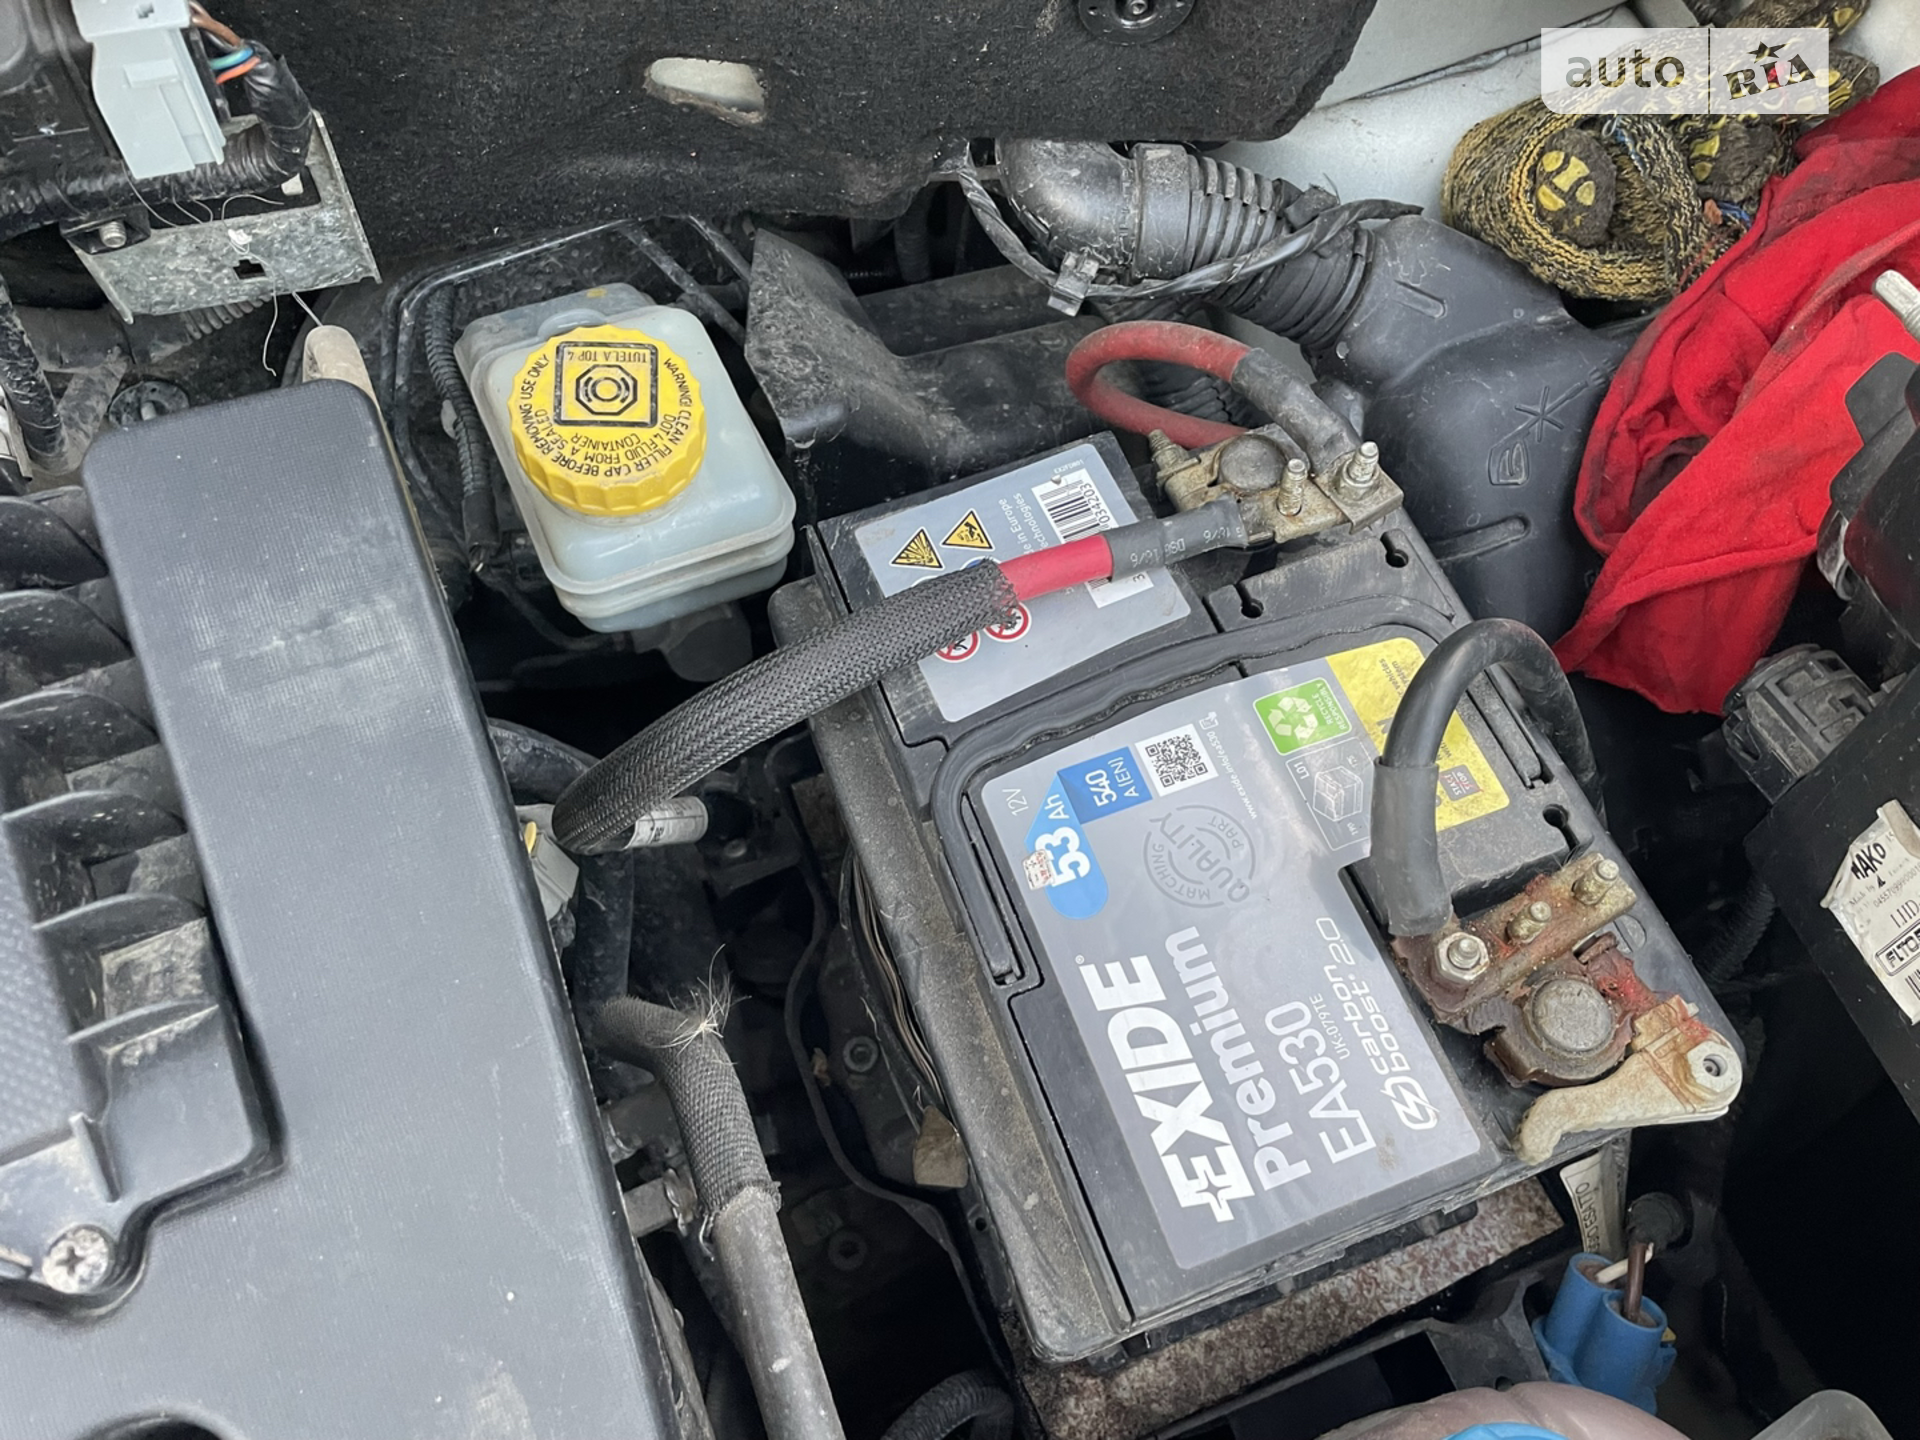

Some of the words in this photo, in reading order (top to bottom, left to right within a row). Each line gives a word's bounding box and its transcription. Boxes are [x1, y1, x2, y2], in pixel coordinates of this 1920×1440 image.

[528, 354, 551, 377] ONLY
[567, 351, 574, 360] 4
[578, 350, 598, 361] TOP
[602, 350, 648, 363] TUTELA
[521, 379, 536, 398] USE
[664, 358, 692, 407] WARNING!
[519, 403, 554, 456] REMOVING
[534, 408, 568, 448] SEALED
[653, 430, 662, 440] 4
[658, 413, 677, 435] DOT
[668, 411, 691, 444] CLEAN
[570, 432, 640, 452] CONTAINER
[570, 445, 579, 456] A
[584, 451, 620, 464] FROM
[624, 439, 655, 461] FLUID
[551, 450, 599, 476] BEFORE
[604, 463, 631, 477] CAP
[634, 447, 672, 471] FILLER
[997, 498, 1022, 533] Europe
[1079, 481, 1110, 523] 034203
[1012, 492, 1049, 548] echnologies
[1014, 532, 1027, 543] in
[1377, 657, 1401, 689] vehicles
[1390, 660, 1410, 685] ystem
[1311, 692, 1333, 724] RECYCLE
[1315, 681, 1347, 729] RESPONSIBLY
[1293, 760, 1310, 779] L01
[1002, 788, 1029, 816] 12V
[1085, 770, 1118, 807] 540
[1121, 784, 1139, 795] A
[1042, 792, 1069, 819] Ah
[1207, 815, 1244, 848] PART
[1036, 827, 1090, 886] 53
[1149, 812, 1249, 902] QUALITY
[1151, 843, 1210, 899] MATCHING
[1316, 916, 1353, 966] 2.0
[1309, 993, 1351, 1060] UK:079TE
[1323, 964, 1388, 1077] carbon
[1353, 981, 1411, 1072] boost
[1164, 926, 1312, 1190] Premium
[1081, 955, 1254, 1223] EXIDE
[1264, 1000, 1376, 1164] EA530
[1575, 1182, 1597, 1228] ESATTO
